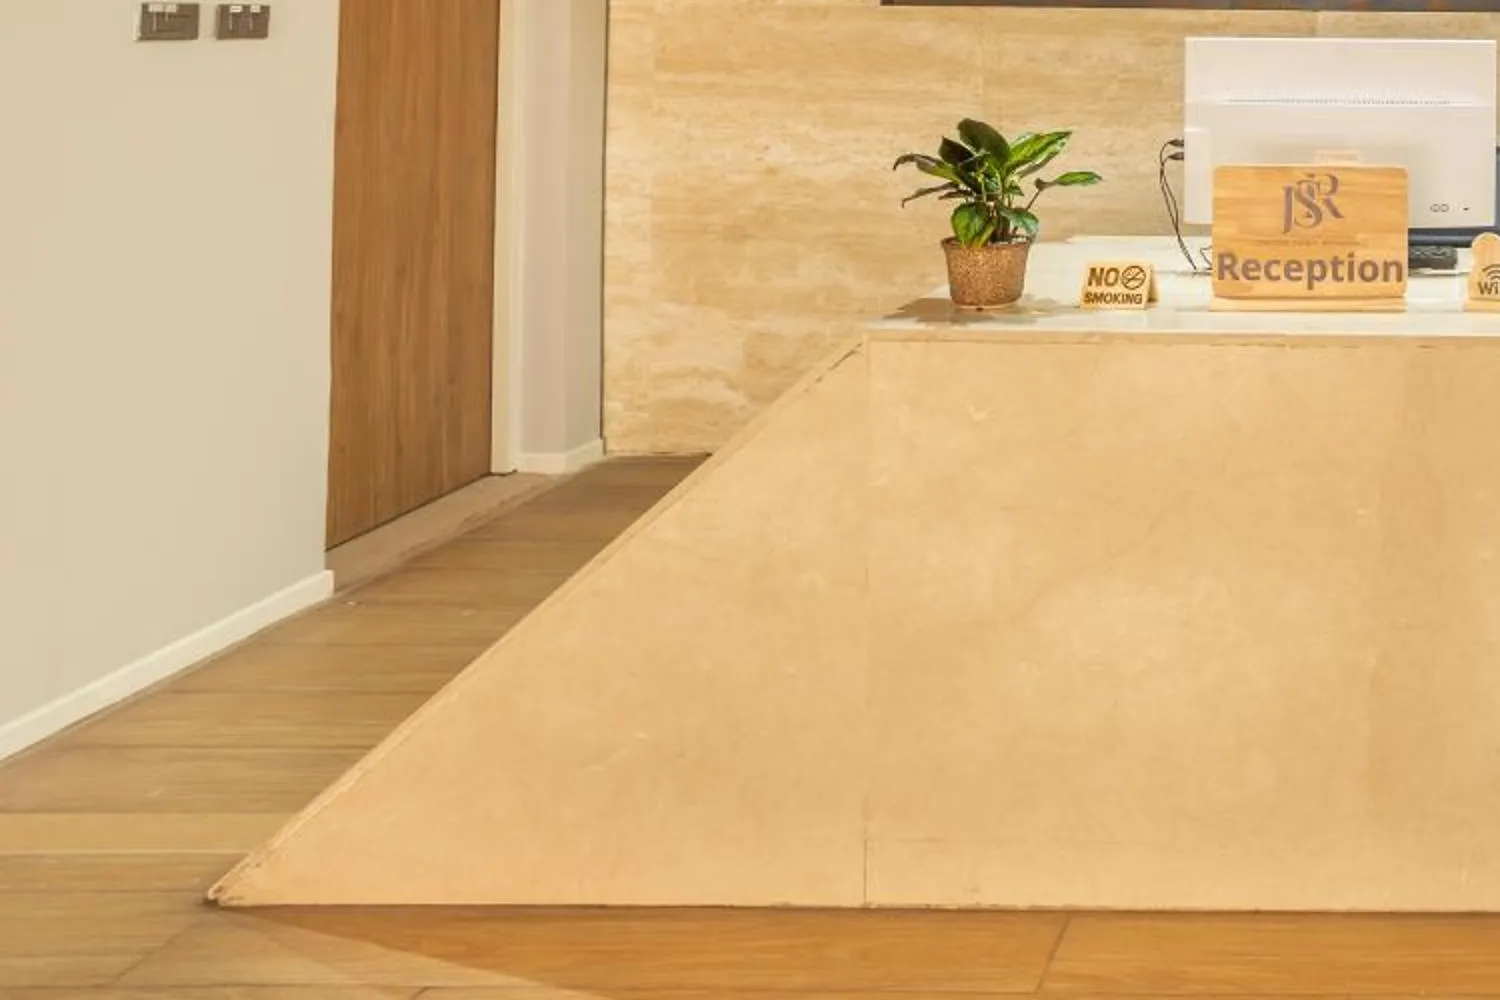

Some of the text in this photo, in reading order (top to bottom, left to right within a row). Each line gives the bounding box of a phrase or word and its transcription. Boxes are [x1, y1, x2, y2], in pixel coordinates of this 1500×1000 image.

[1087, 267, 1120, 287] NO
[1218, 251, 1403, 291] Reception
[1084, 291, 1143, 304] SMOKING
